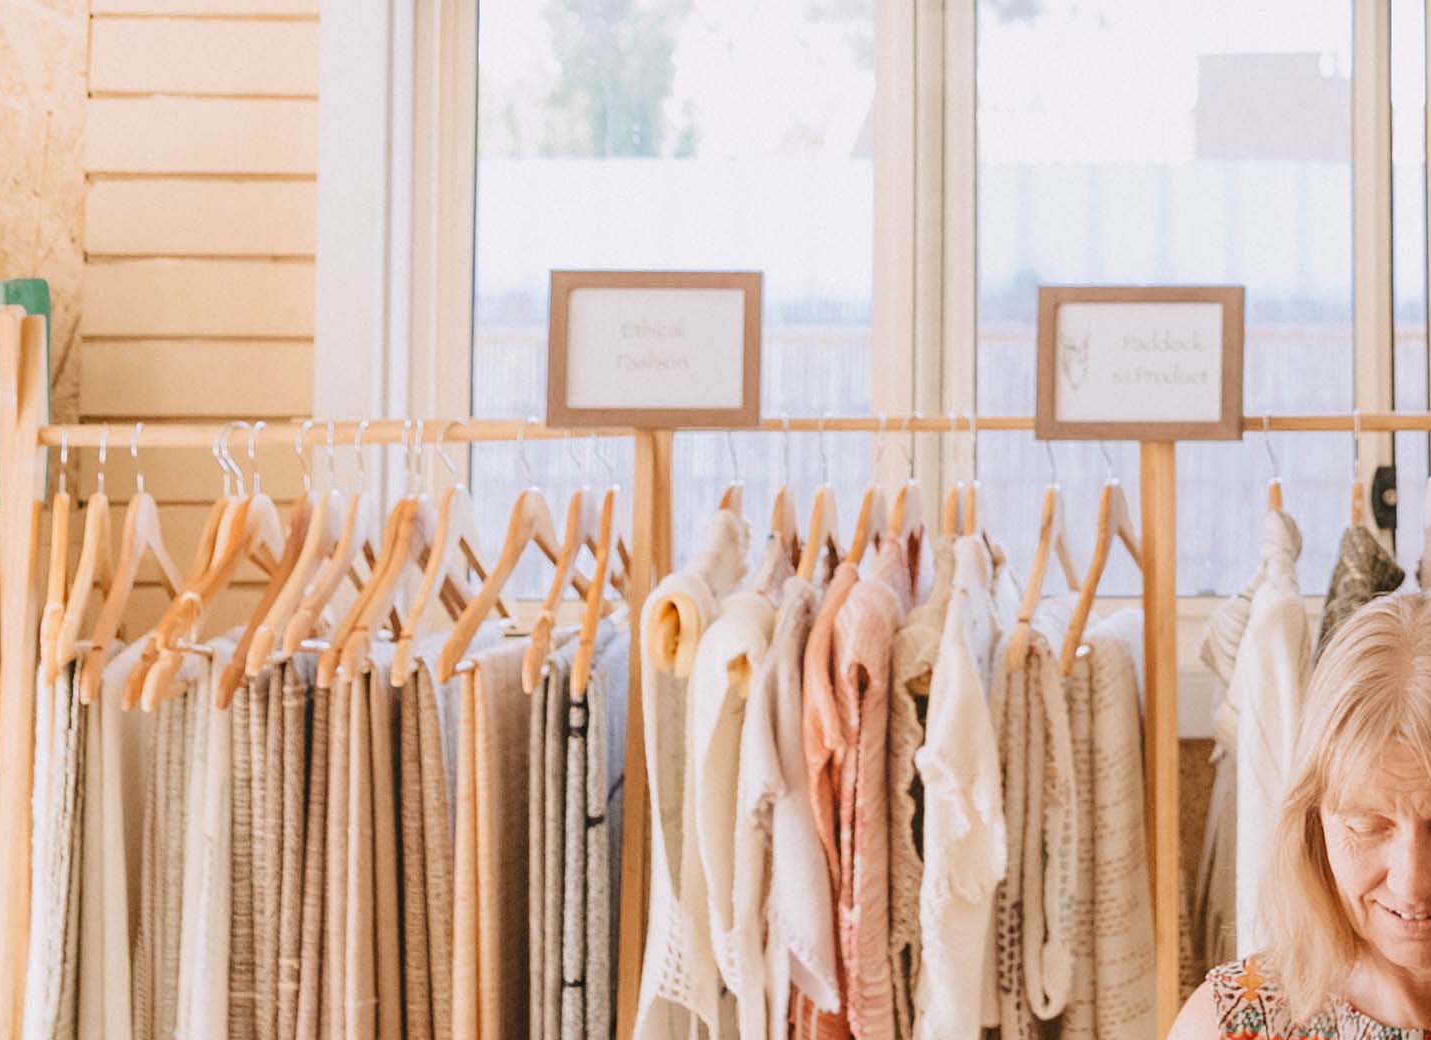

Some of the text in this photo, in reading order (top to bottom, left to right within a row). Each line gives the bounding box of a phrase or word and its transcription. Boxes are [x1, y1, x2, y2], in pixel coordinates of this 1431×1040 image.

[620, 316, 687, 339] Ethical
[1122, 327, 1204, 352] Paddock
[615, 348, 690, 371] Fashion
[1129, 360, 1209, 385] Product
